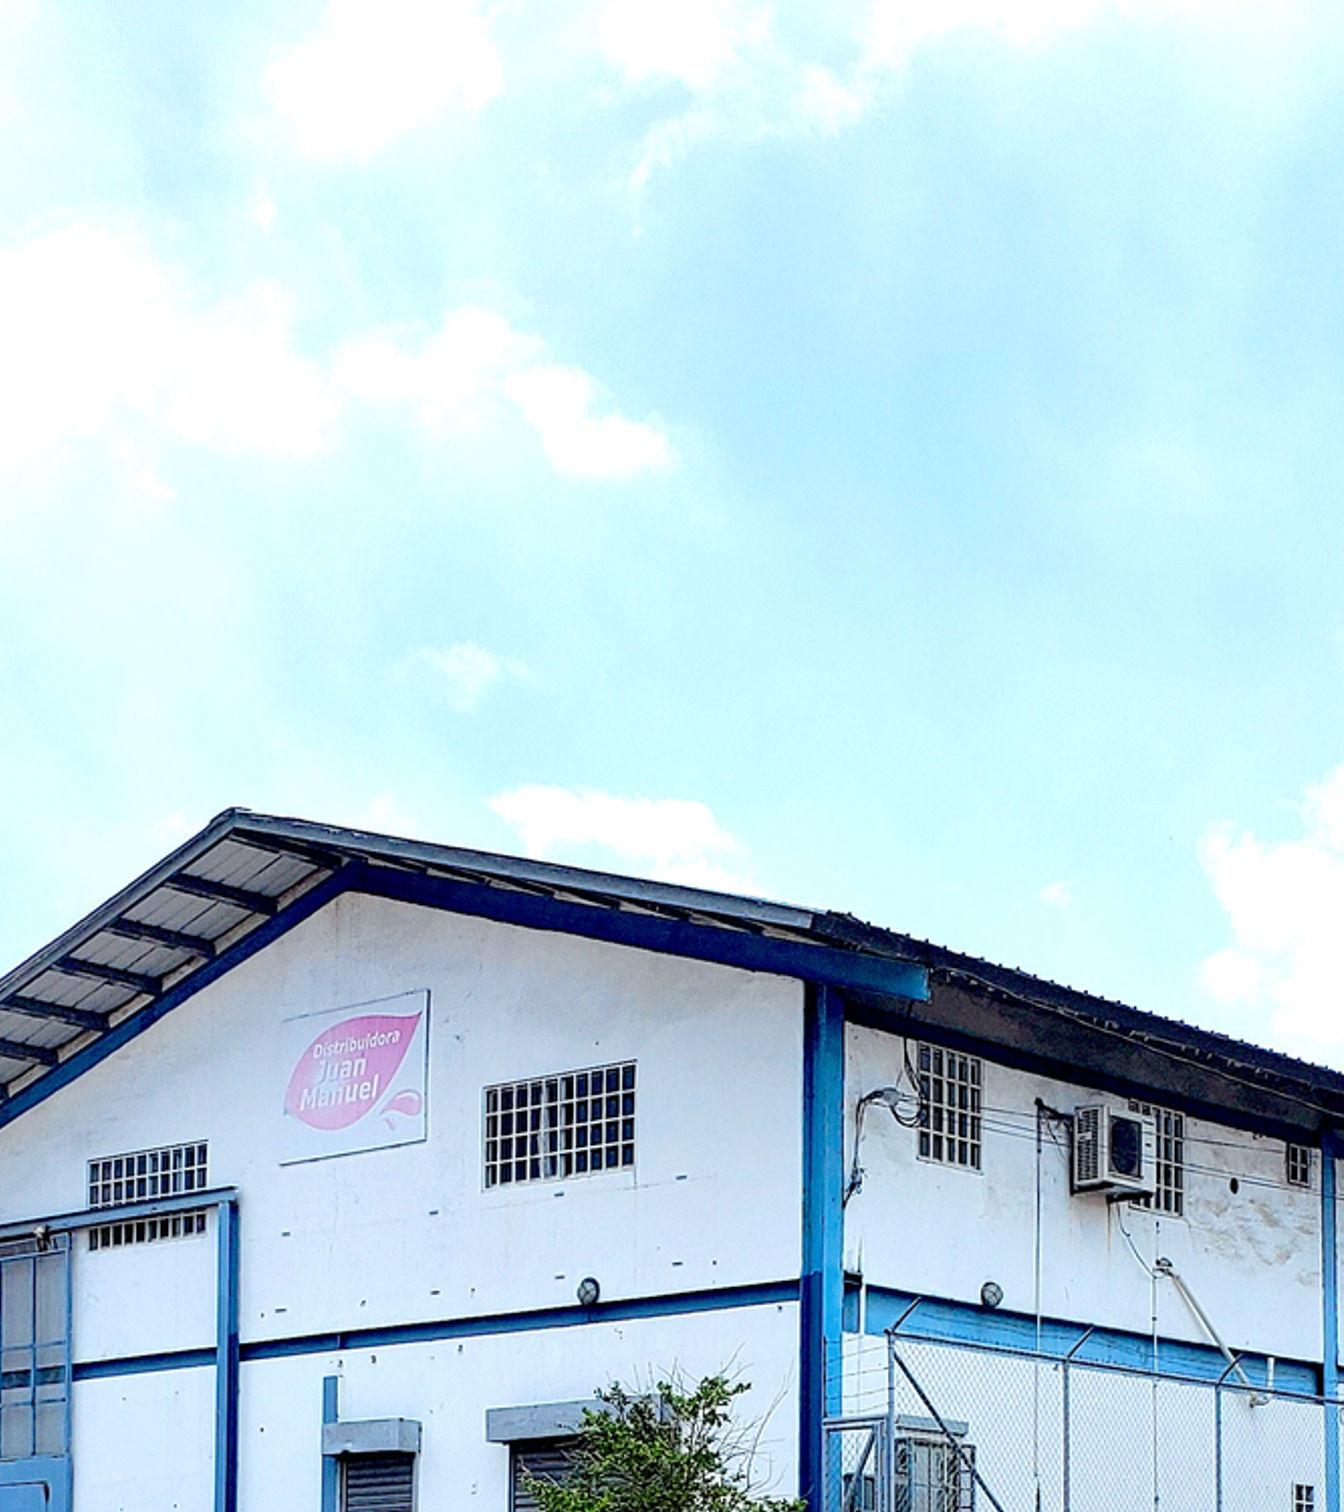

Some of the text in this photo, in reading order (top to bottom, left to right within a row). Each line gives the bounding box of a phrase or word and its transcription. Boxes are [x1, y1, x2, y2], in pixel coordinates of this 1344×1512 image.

[313, 1029, 401, 1059] Distribuidora
[316, 1057, 367, 1084] Juan
[300, 1073, 380, 1112] Manuel
